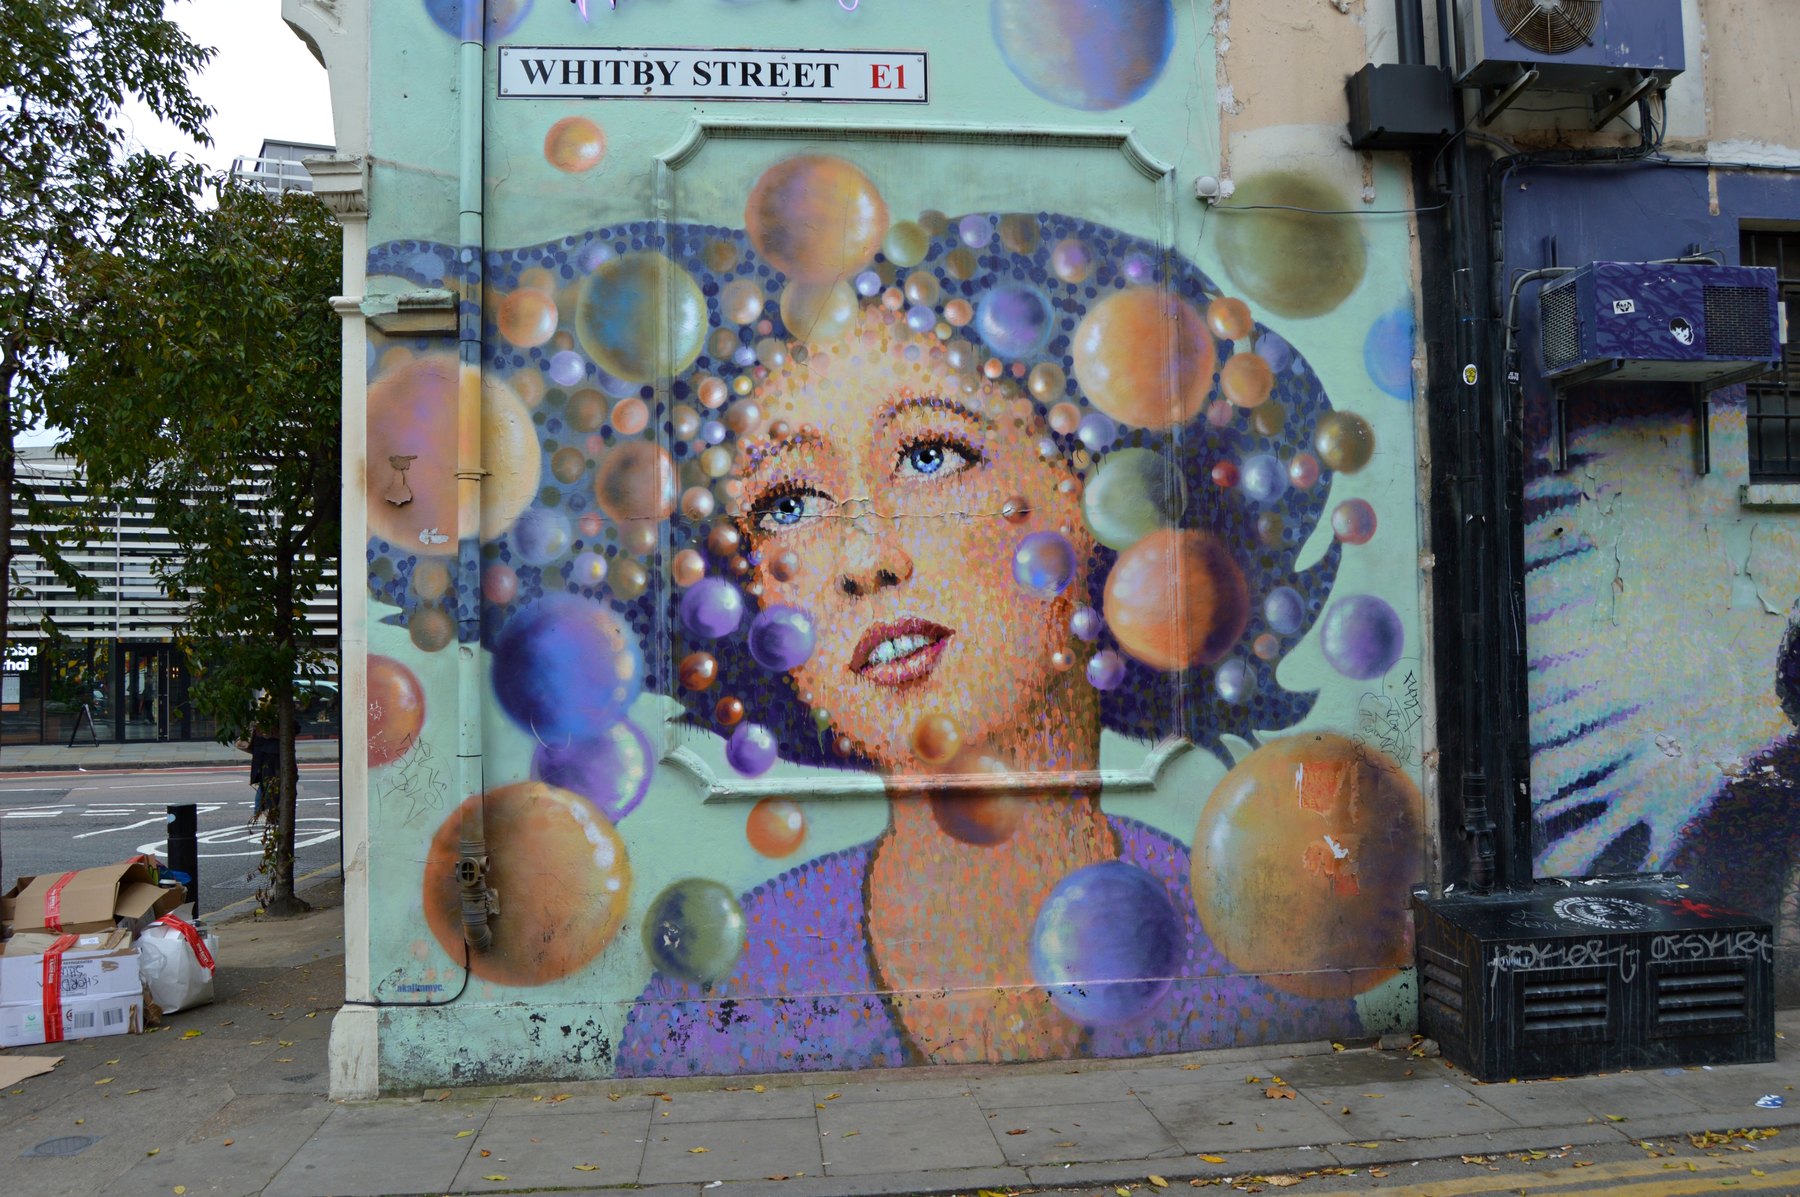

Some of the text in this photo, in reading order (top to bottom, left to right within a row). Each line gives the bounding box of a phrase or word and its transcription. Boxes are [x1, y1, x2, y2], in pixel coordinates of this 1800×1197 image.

[521, 60, 907, 89] WHITBY STREET E1
